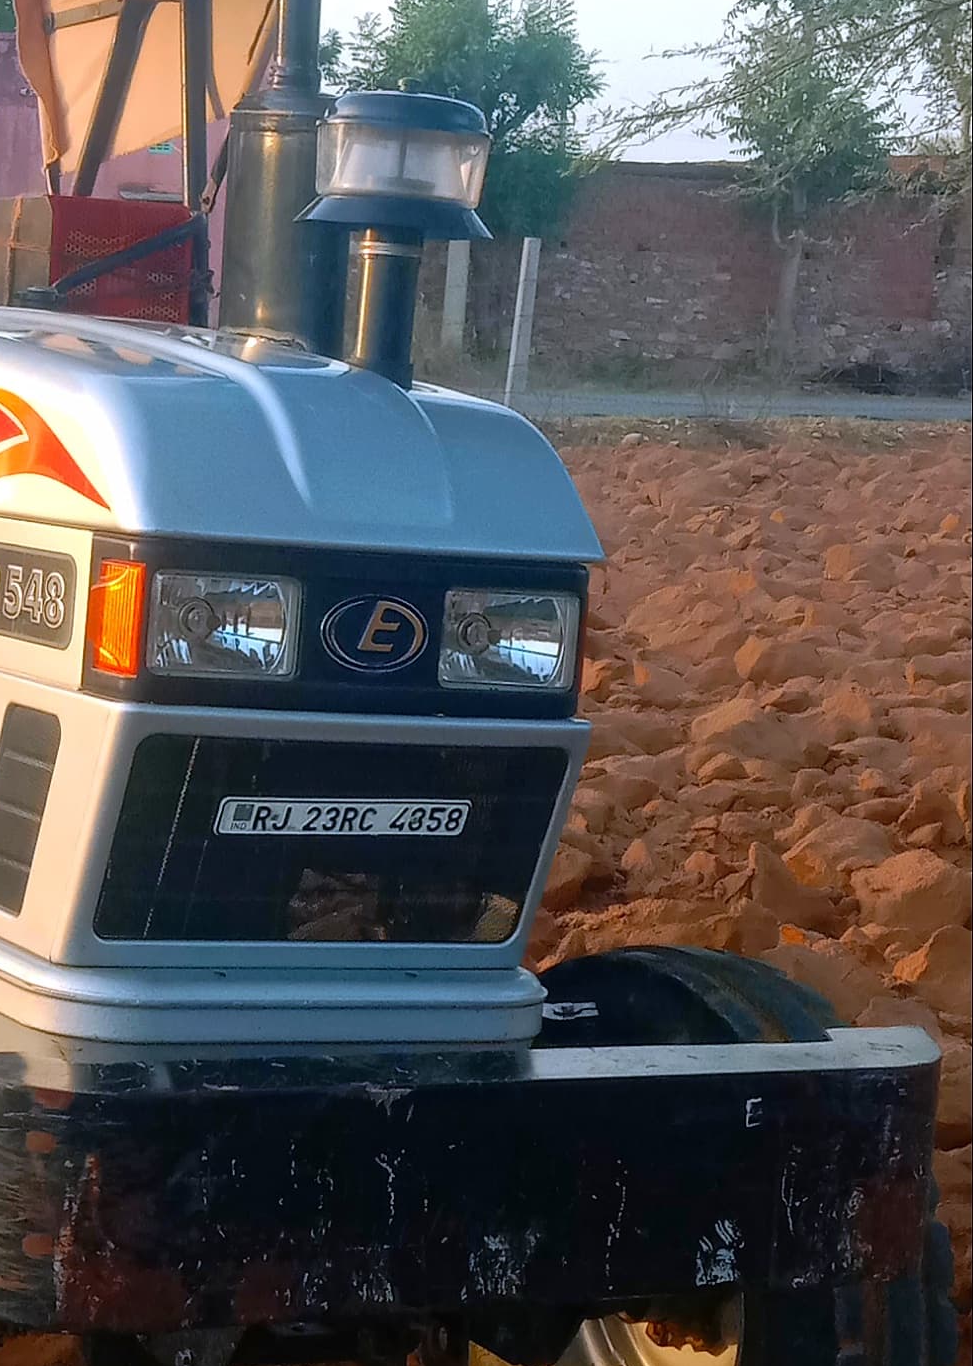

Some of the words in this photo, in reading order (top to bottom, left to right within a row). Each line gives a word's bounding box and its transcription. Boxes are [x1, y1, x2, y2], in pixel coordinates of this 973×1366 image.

[2, 564, 66, 629] 548
[252, 805, 292, 831] RJ
[302, 806, 377, 832] 23RC
